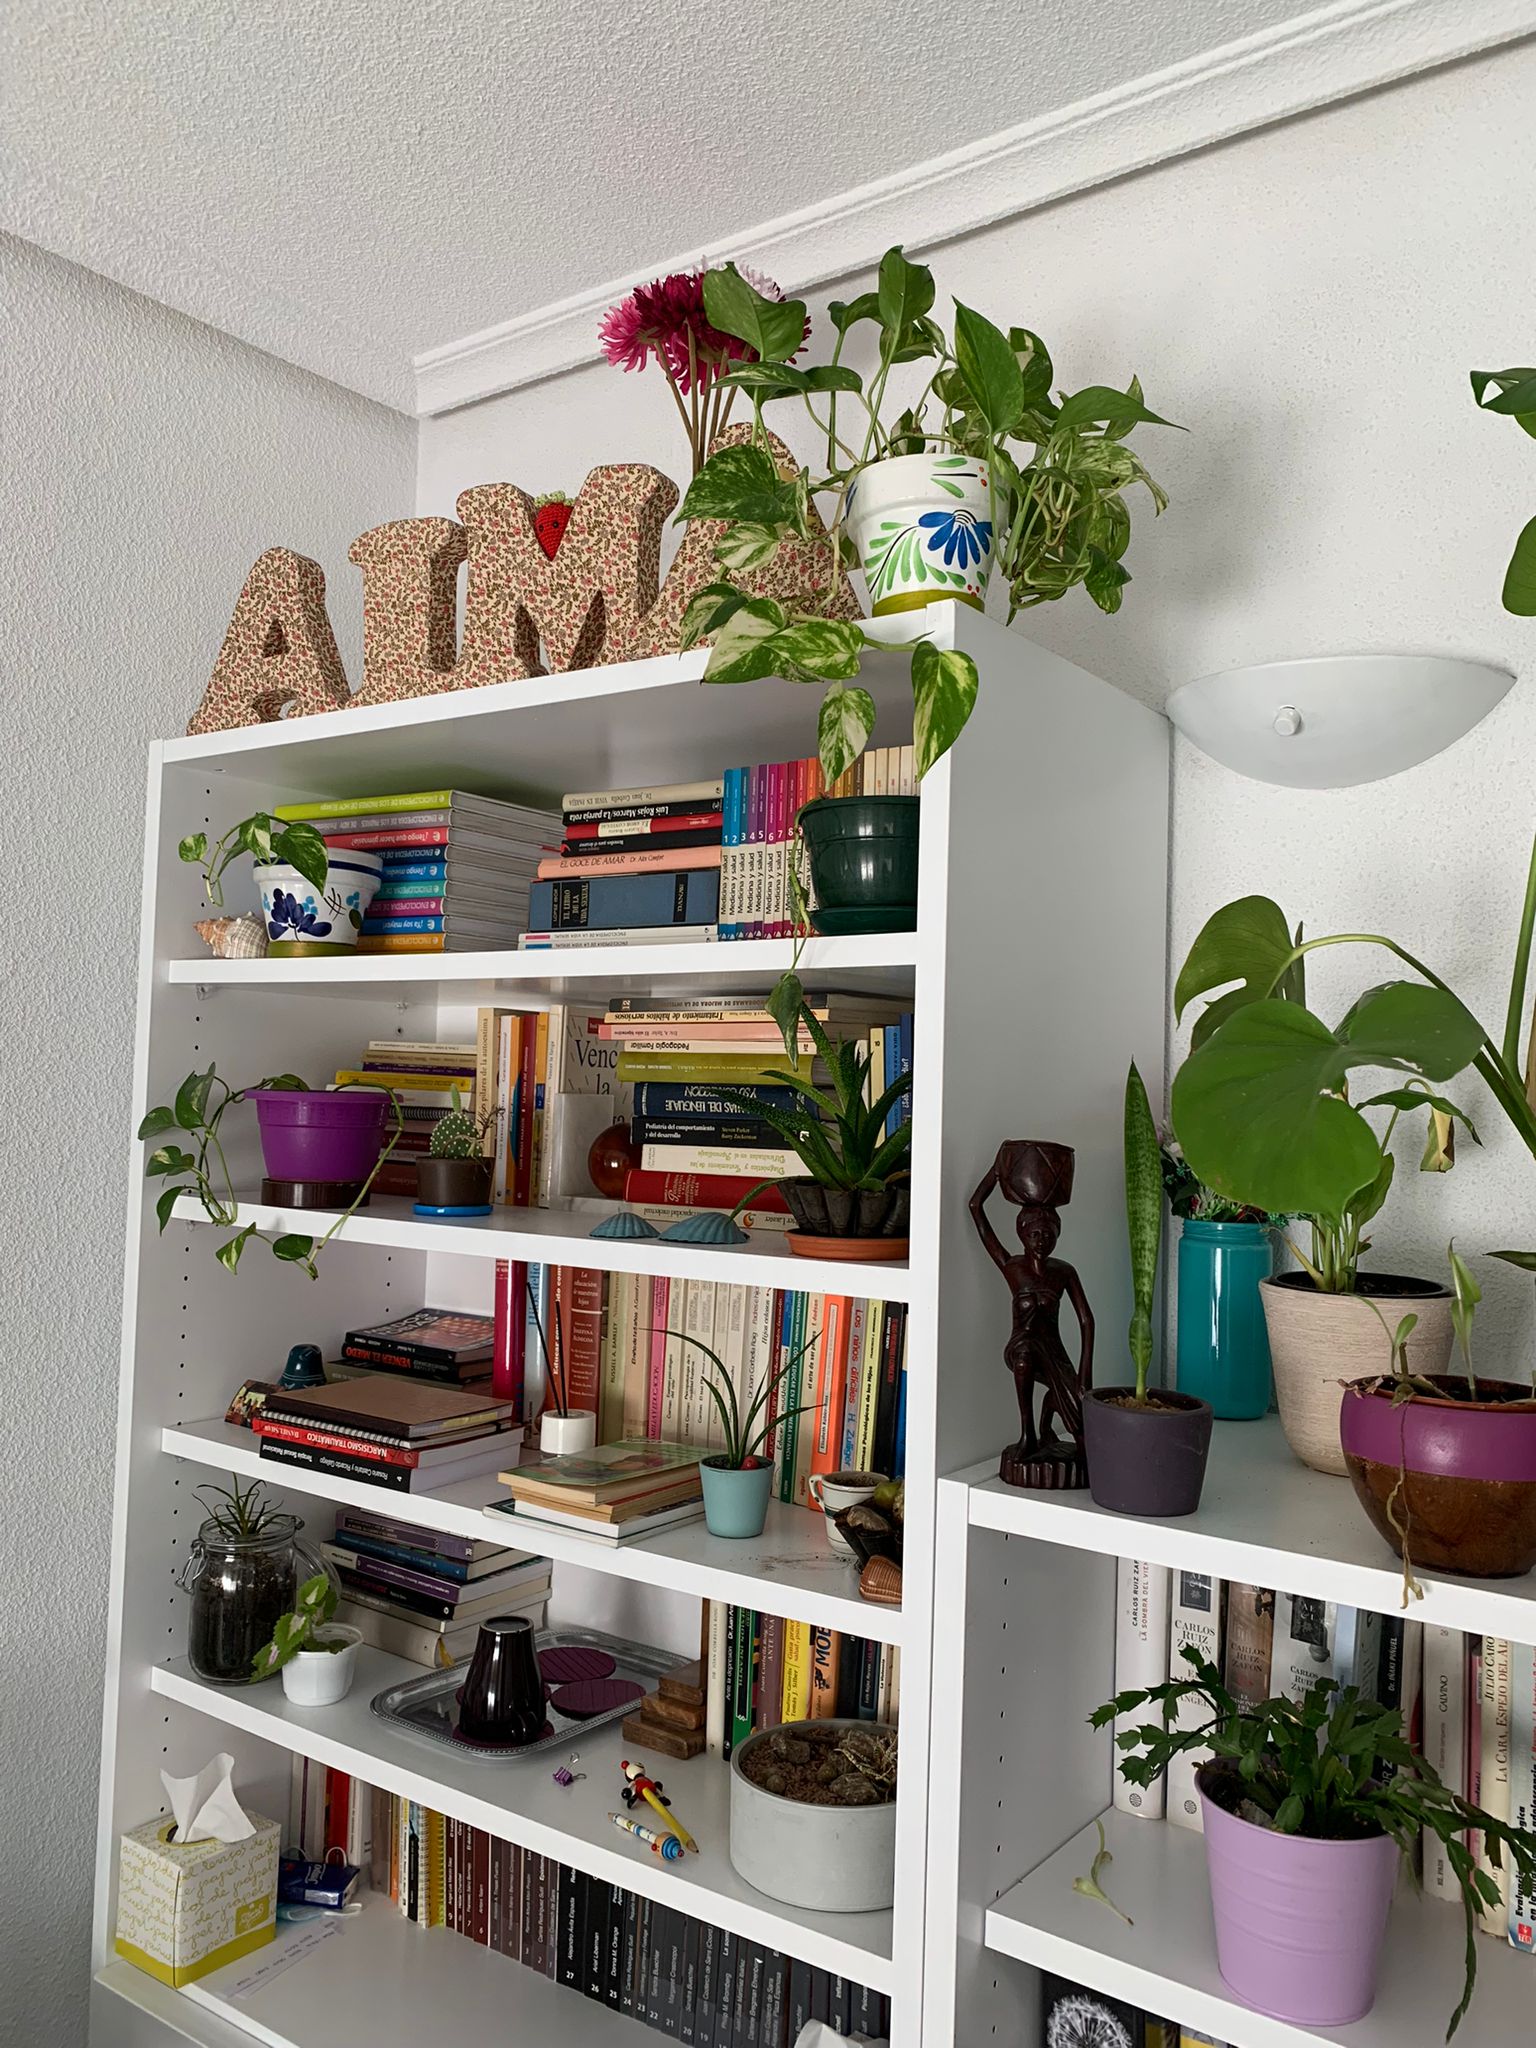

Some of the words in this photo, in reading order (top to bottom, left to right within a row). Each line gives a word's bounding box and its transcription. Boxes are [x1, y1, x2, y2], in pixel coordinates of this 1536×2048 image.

[570, 813, 582, 821] rota
[583, 810, 603, 822] pareja
[637, 806, 654, 817] Rojas
[656, 806, 669, 816] Luis
[724, 834, 728, 844] 1
[732, 835, 738, 844] 2
[741, 832, 746, 840] 3
[750, 832, 755, 840] 4
[758, 830, 764, 838] 5
[769, 832, 774, 840] 6
[778, 830, 783, 838] 7
[560, 860, 568, 868] EL
[570, 858, 590, 867] GOCE
[591, 858, 602, 866] DE
[602, 856, 625, 866] AMAR
[720, 882, 728, 915] Medicina
[404, 920, 412, 928] soy
[622, 1000, 630, 1009] 12
[646, 1013, 670, 1021] hábitos
[682, 1012, 724, 1020] Tratamiento
[480, 1018, 488, 1058] autoestima
[630, 1042, 654, 1050] Familiar
[480, 1066, 487, 1076] de
[480, 1078, 488, 1102] pilares
[596, 1074, 610, 1094] la
[666, 1100, 706, 1112] LENGUAJE
[708, 1102, 722, 1112] DEL
[763, 1300, 771, 1324] celosos
[854, 1309, 863, 1328] Los
[750, 1332, 758, 1346] Roig
[761, 1324, 771, 1344] Hijos
[851, 1335, 861, 1362] niños
[748, 1347, 756, 1374] Corbella
[849, 1367, 859, 1404] difíciles
[307, 1432, 347, 1450] TRAUMÁTICO
[262, 1444, 283, 1456] Relacional
[283, 1448, 297, 1459] Sexual
[348, 1440, 387, 1457] NARCISISMO
[845, 1431, 855, 1466] Zulliger
[298, 1450, 313, 1462] Terapia
[320, 1456, 335, 1469] Gallego
[335, 1461, 351, 1473] Ricardo
[355, 1464, 372, 1477] Castaño
[372, 1470, 388, 1481] Rosario
[1175, 1619, 1216, 1636] CARLOS
[1142, 1632, 1147, 1640] LA
[1182, 1631, 1208, 1644] RUIZ
[1231, 1643, 1266, 1655] CARLOS
[1389, 1637, 1397, 1661] PIÑUEL
[1484, 1636, 1494, 1667] CARO
[1236, 1652, 1260, 1663] RUIZ
[1290, 1666, 1319, 1679] CARLOS
[1388, 1662, 1396, 1681] IÑAKI
[1498, 1660, 1508, 1681] DEL
[1295, 1676, 1314, 1686] RUIZ
[1484, 1669, 1495, 1702] JULIO
[1440, 1675, 1448, 1712] CALVINO
[1496, 1685, 1508, 1727] ESPEJO
[1495, 1732, 1508, 1764] CARA,
[1495, 1767, 1508, 1782] LA
[566, 1971, 574, 1979] 27
[592, 1984, 599, 1993] 26
[668, 1978, 676, 2004] Margaret
[723, 1973, 731, 2002] Bromberg
[609, 1990, 617, 1998] 25
[624, 1997, 631, 2006] 24
[637, 2003, 645, 2012] 23
[650, 2011, 658, 2020] 22
[666, 2018, 673, 2027] 21
[683, 2026, 692, 2035] 20
[700, 2033, 708, 2041] 19
